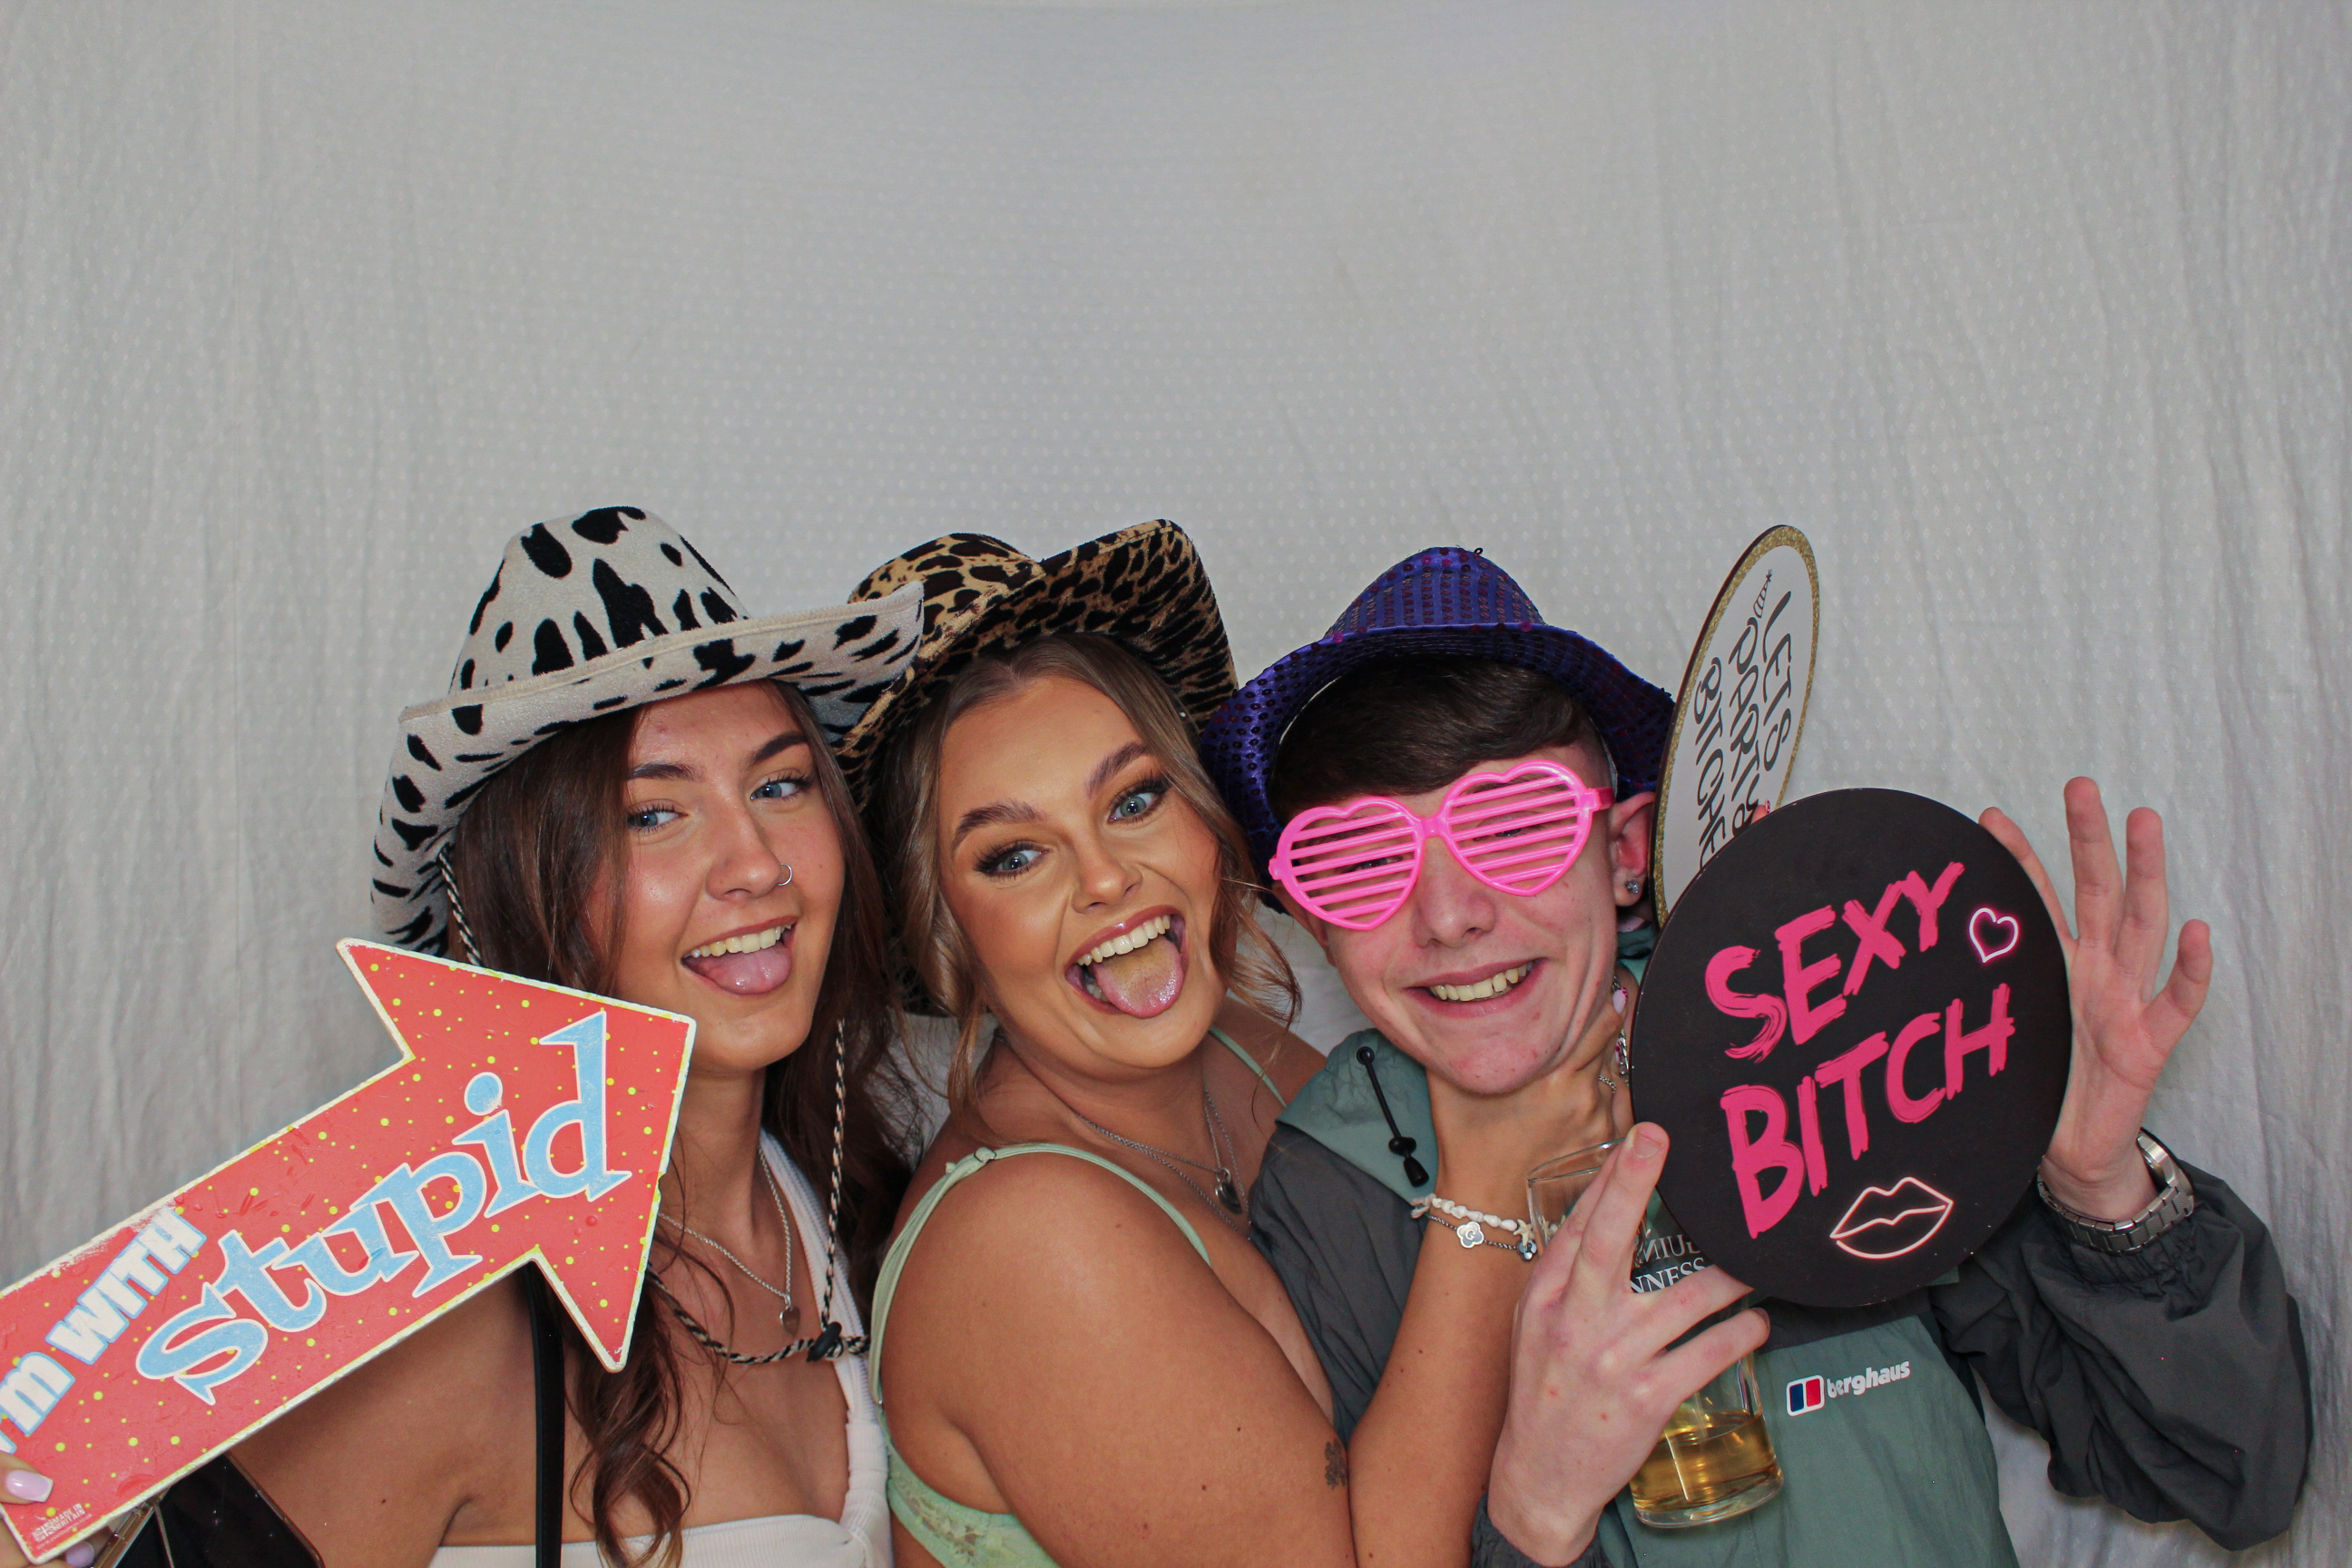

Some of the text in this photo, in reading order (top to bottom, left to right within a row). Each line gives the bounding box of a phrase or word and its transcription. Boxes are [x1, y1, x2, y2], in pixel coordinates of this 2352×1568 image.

[1694, 656, 1727, 870] BITCHE
[1762, 591, 1792, 771] LETS
[1705, 861, 1965, 1063] SEXY
[1720, 983, 2016, 1239] BITCH
[45, 1205, 207, 1365] WITH
[1630, 1258, 1706, 1293] NNESS
[1827, 1360, 1911, 1398] berghaus
